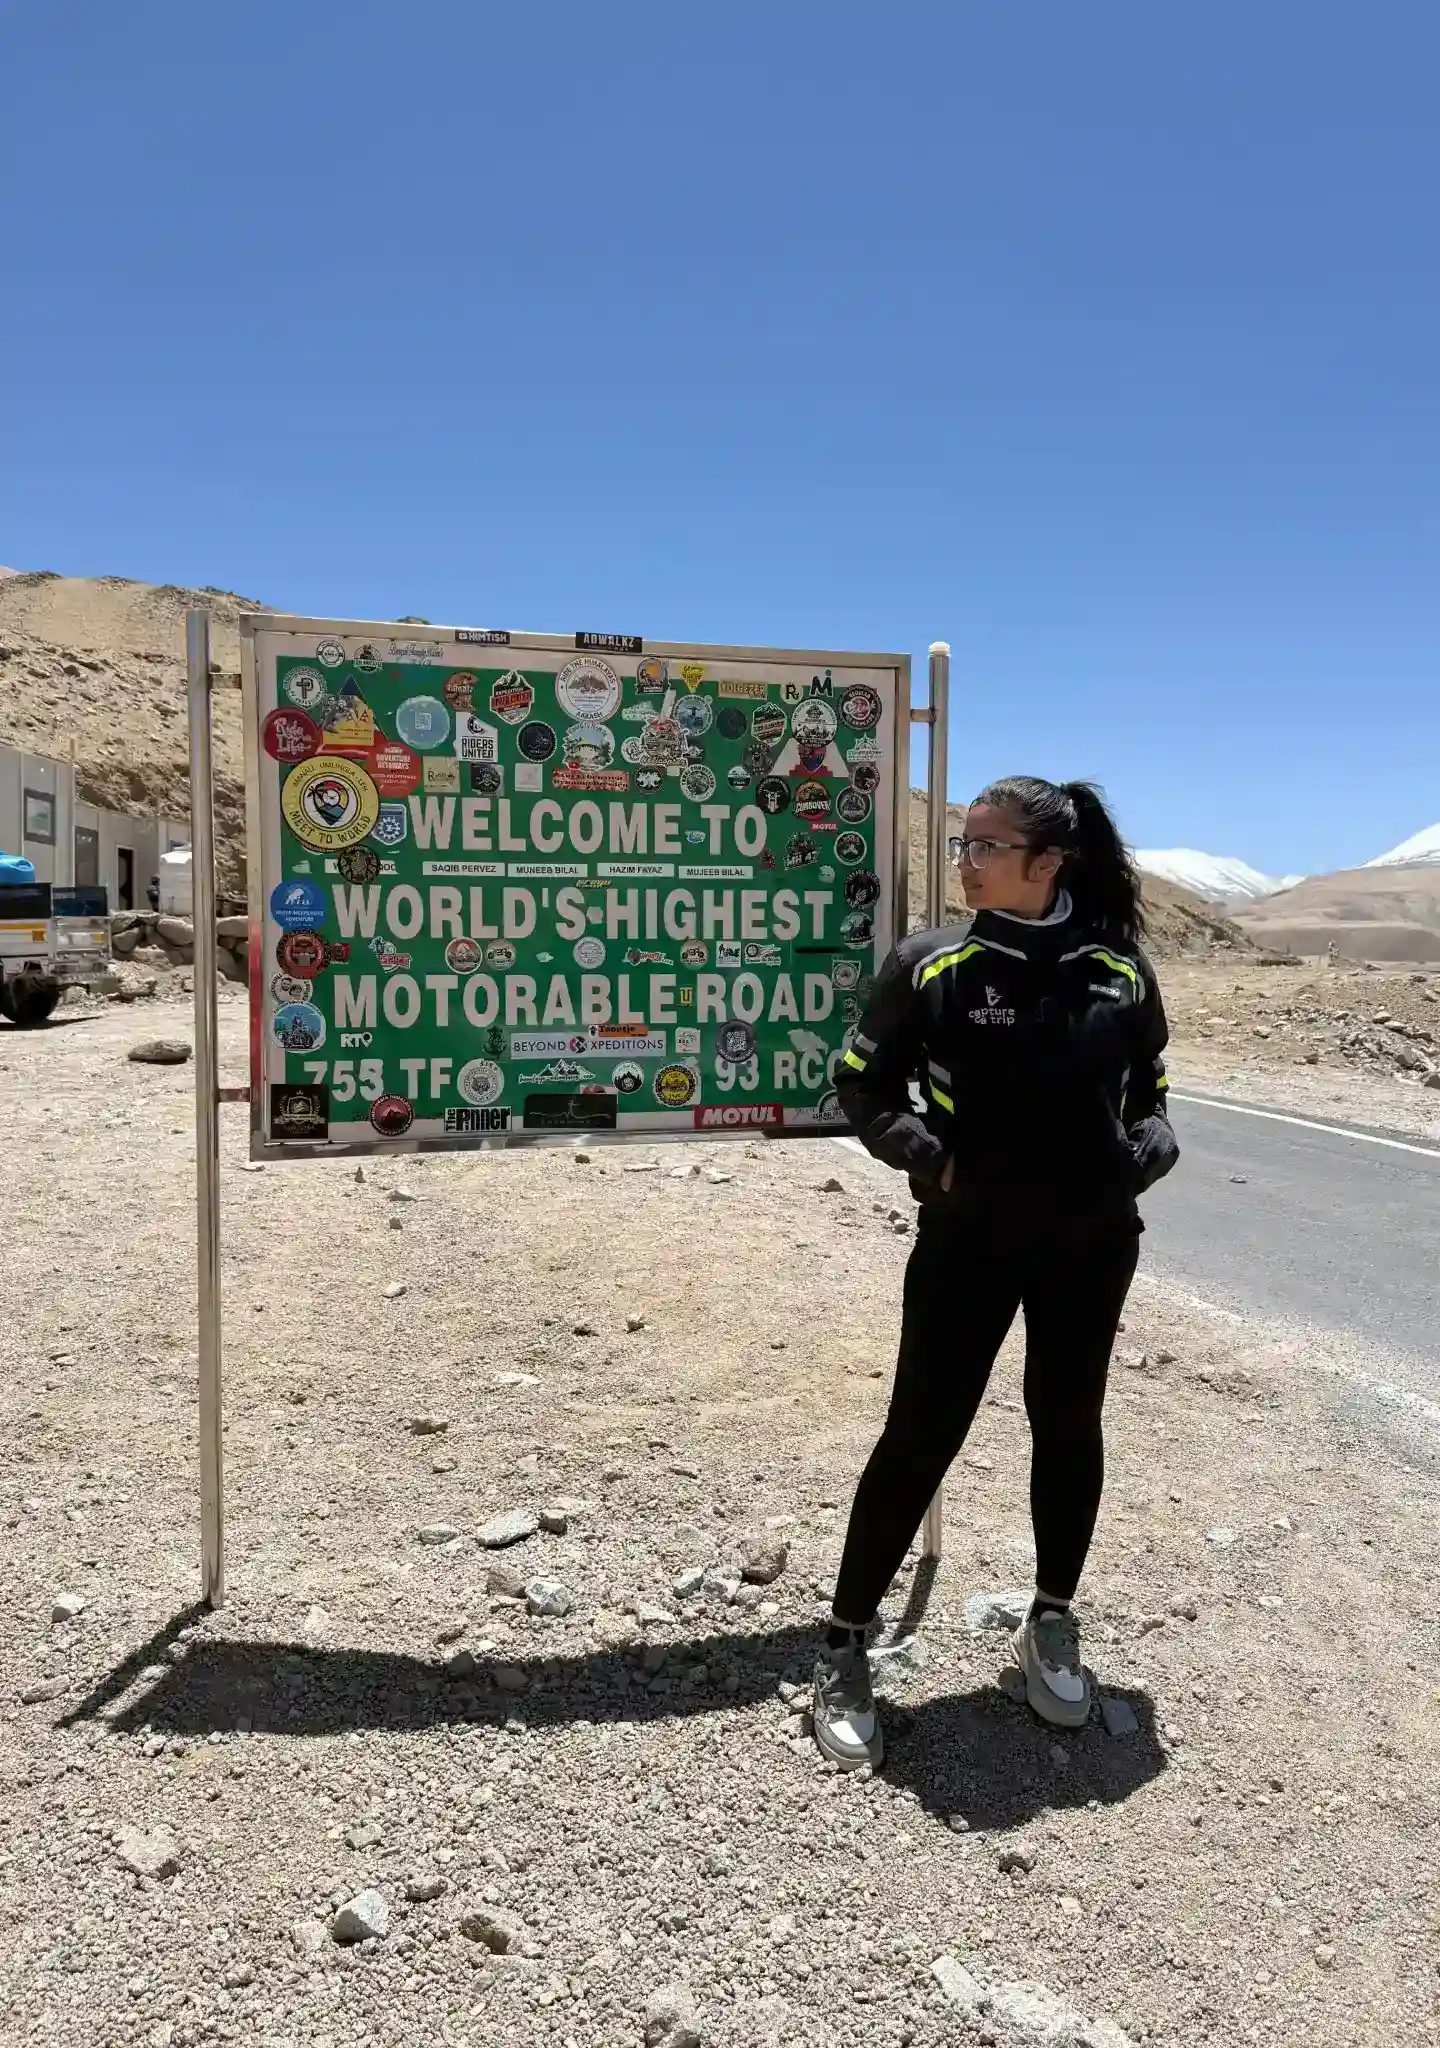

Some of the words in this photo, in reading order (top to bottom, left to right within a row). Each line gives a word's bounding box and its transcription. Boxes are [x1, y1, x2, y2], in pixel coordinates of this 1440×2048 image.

[469, 631, 508, 643] HIMTISH
[583, 632, 635, 648] ADWALKZ
[560, 666, 574, 683] RIDE
[571, 658, 584, 670] THE
[583, 657, 616, 684] HIMALAYAS
[461, 737, 494, 750] RIDERS
[376, 754, 411, 763] ADVENTURE
[461, 749, 494, 759] UNITED
[293, 765, 316, 788] MANALI
[290, 810, 316, 837] MEET
[318, 832, 333, 844] TO
[337, 816, 371, 843] WORLD
[408, 795, 682, 854] WELCOME
[700, 804, 768, 857] TO
[431, 864, 460, 873] SAQIB
[462, 865, 497, 873] PERVEZ
[516, 866, 553, 874] MUNEEB
[555, 866, 578, 874] BILAL
[609, 866, 636, 874] HAZIM
[637, 866, 663, 874] FAYAZ
[686, 868, 720, 876] MUJEEB
[721, 868, 745, 876] BILAL
[332, 884, 586, 941] WORLD'S
[606, 887, 834, 941] HIGHEST
[333, 973, 677, 1028] MOTORABLE
[697, 972, 834, 1024] ROAD
[968, 1007, 1015, 1019] capture
[990, 1016, 1015, 1026] trip
[513, 1041, 566, 1052] BEYOND
[400, 1057, 453, 1100] TF
[715, 1053, 760, 1092] 93
[702, 1106, 776, 1125] MOTUL
